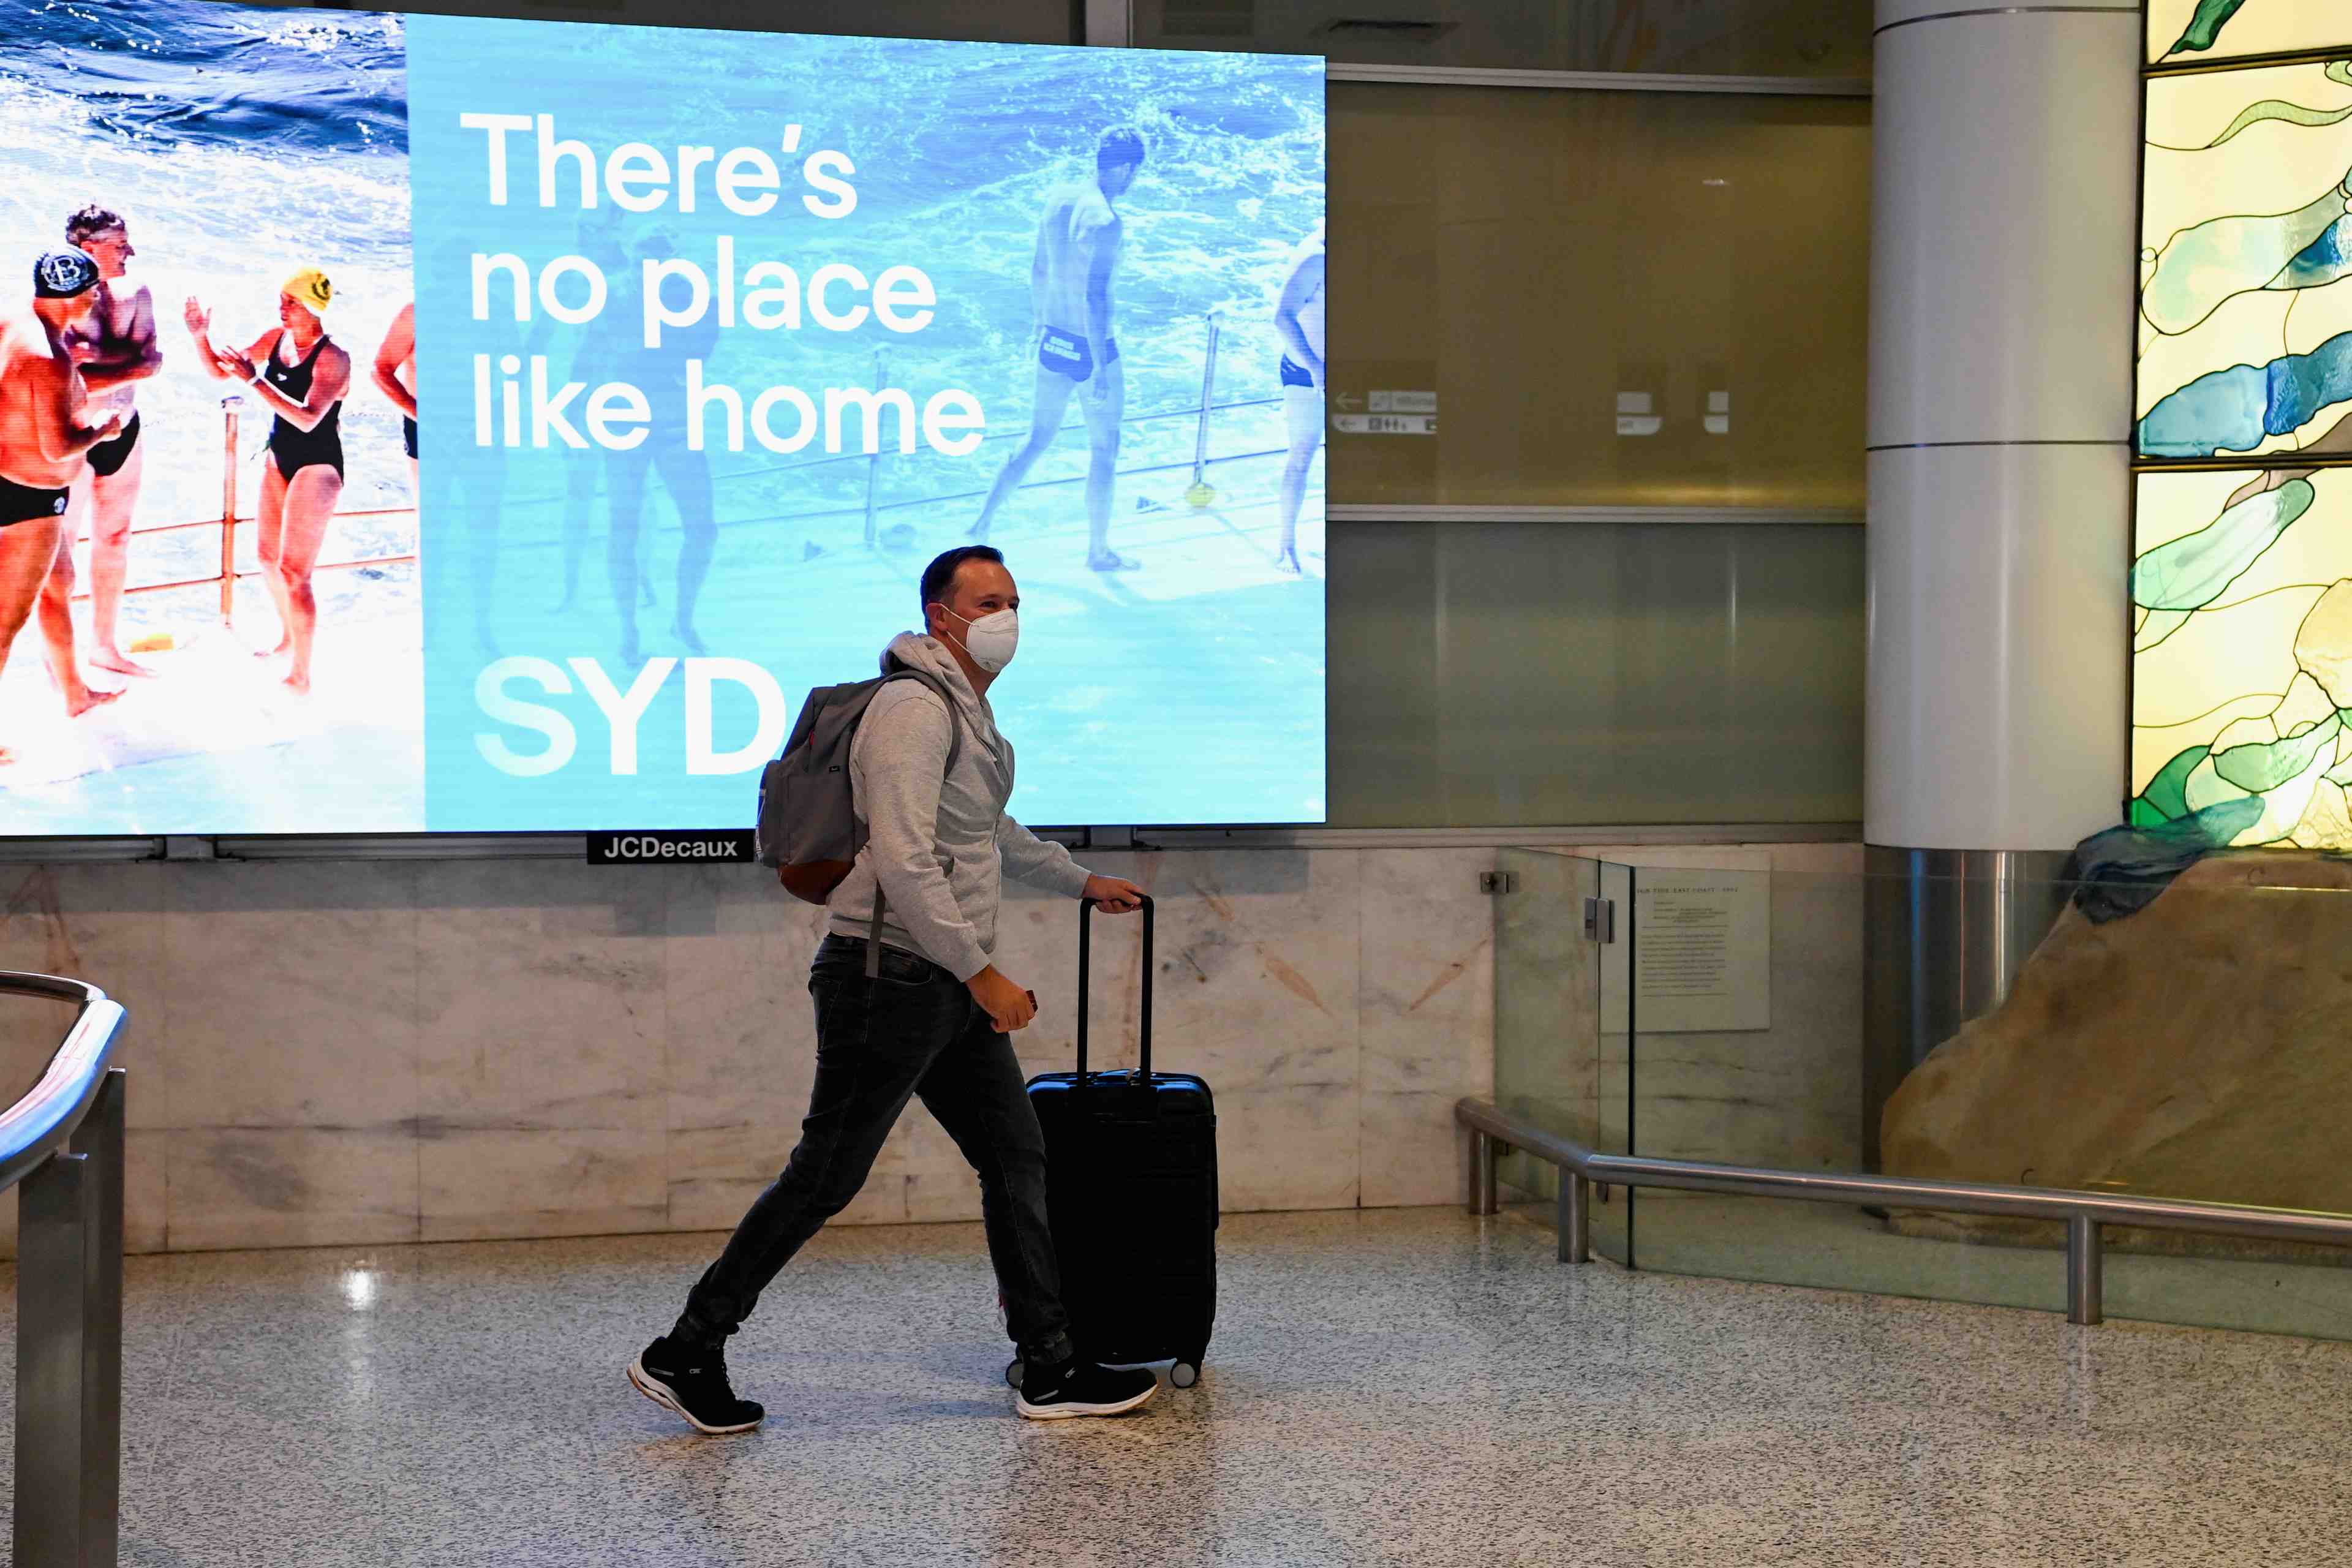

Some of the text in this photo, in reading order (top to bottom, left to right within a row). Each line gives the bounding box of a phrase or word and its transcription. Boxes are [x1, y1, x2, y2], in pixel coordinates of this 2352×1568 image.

[459, 113, 858, 219] There's
[472, 235, 937, 349] no place
[474, 354, 986, 456] like home
[473, 654, 786, 776] SYD
[604, 837, 737, 858] JCDecaux
